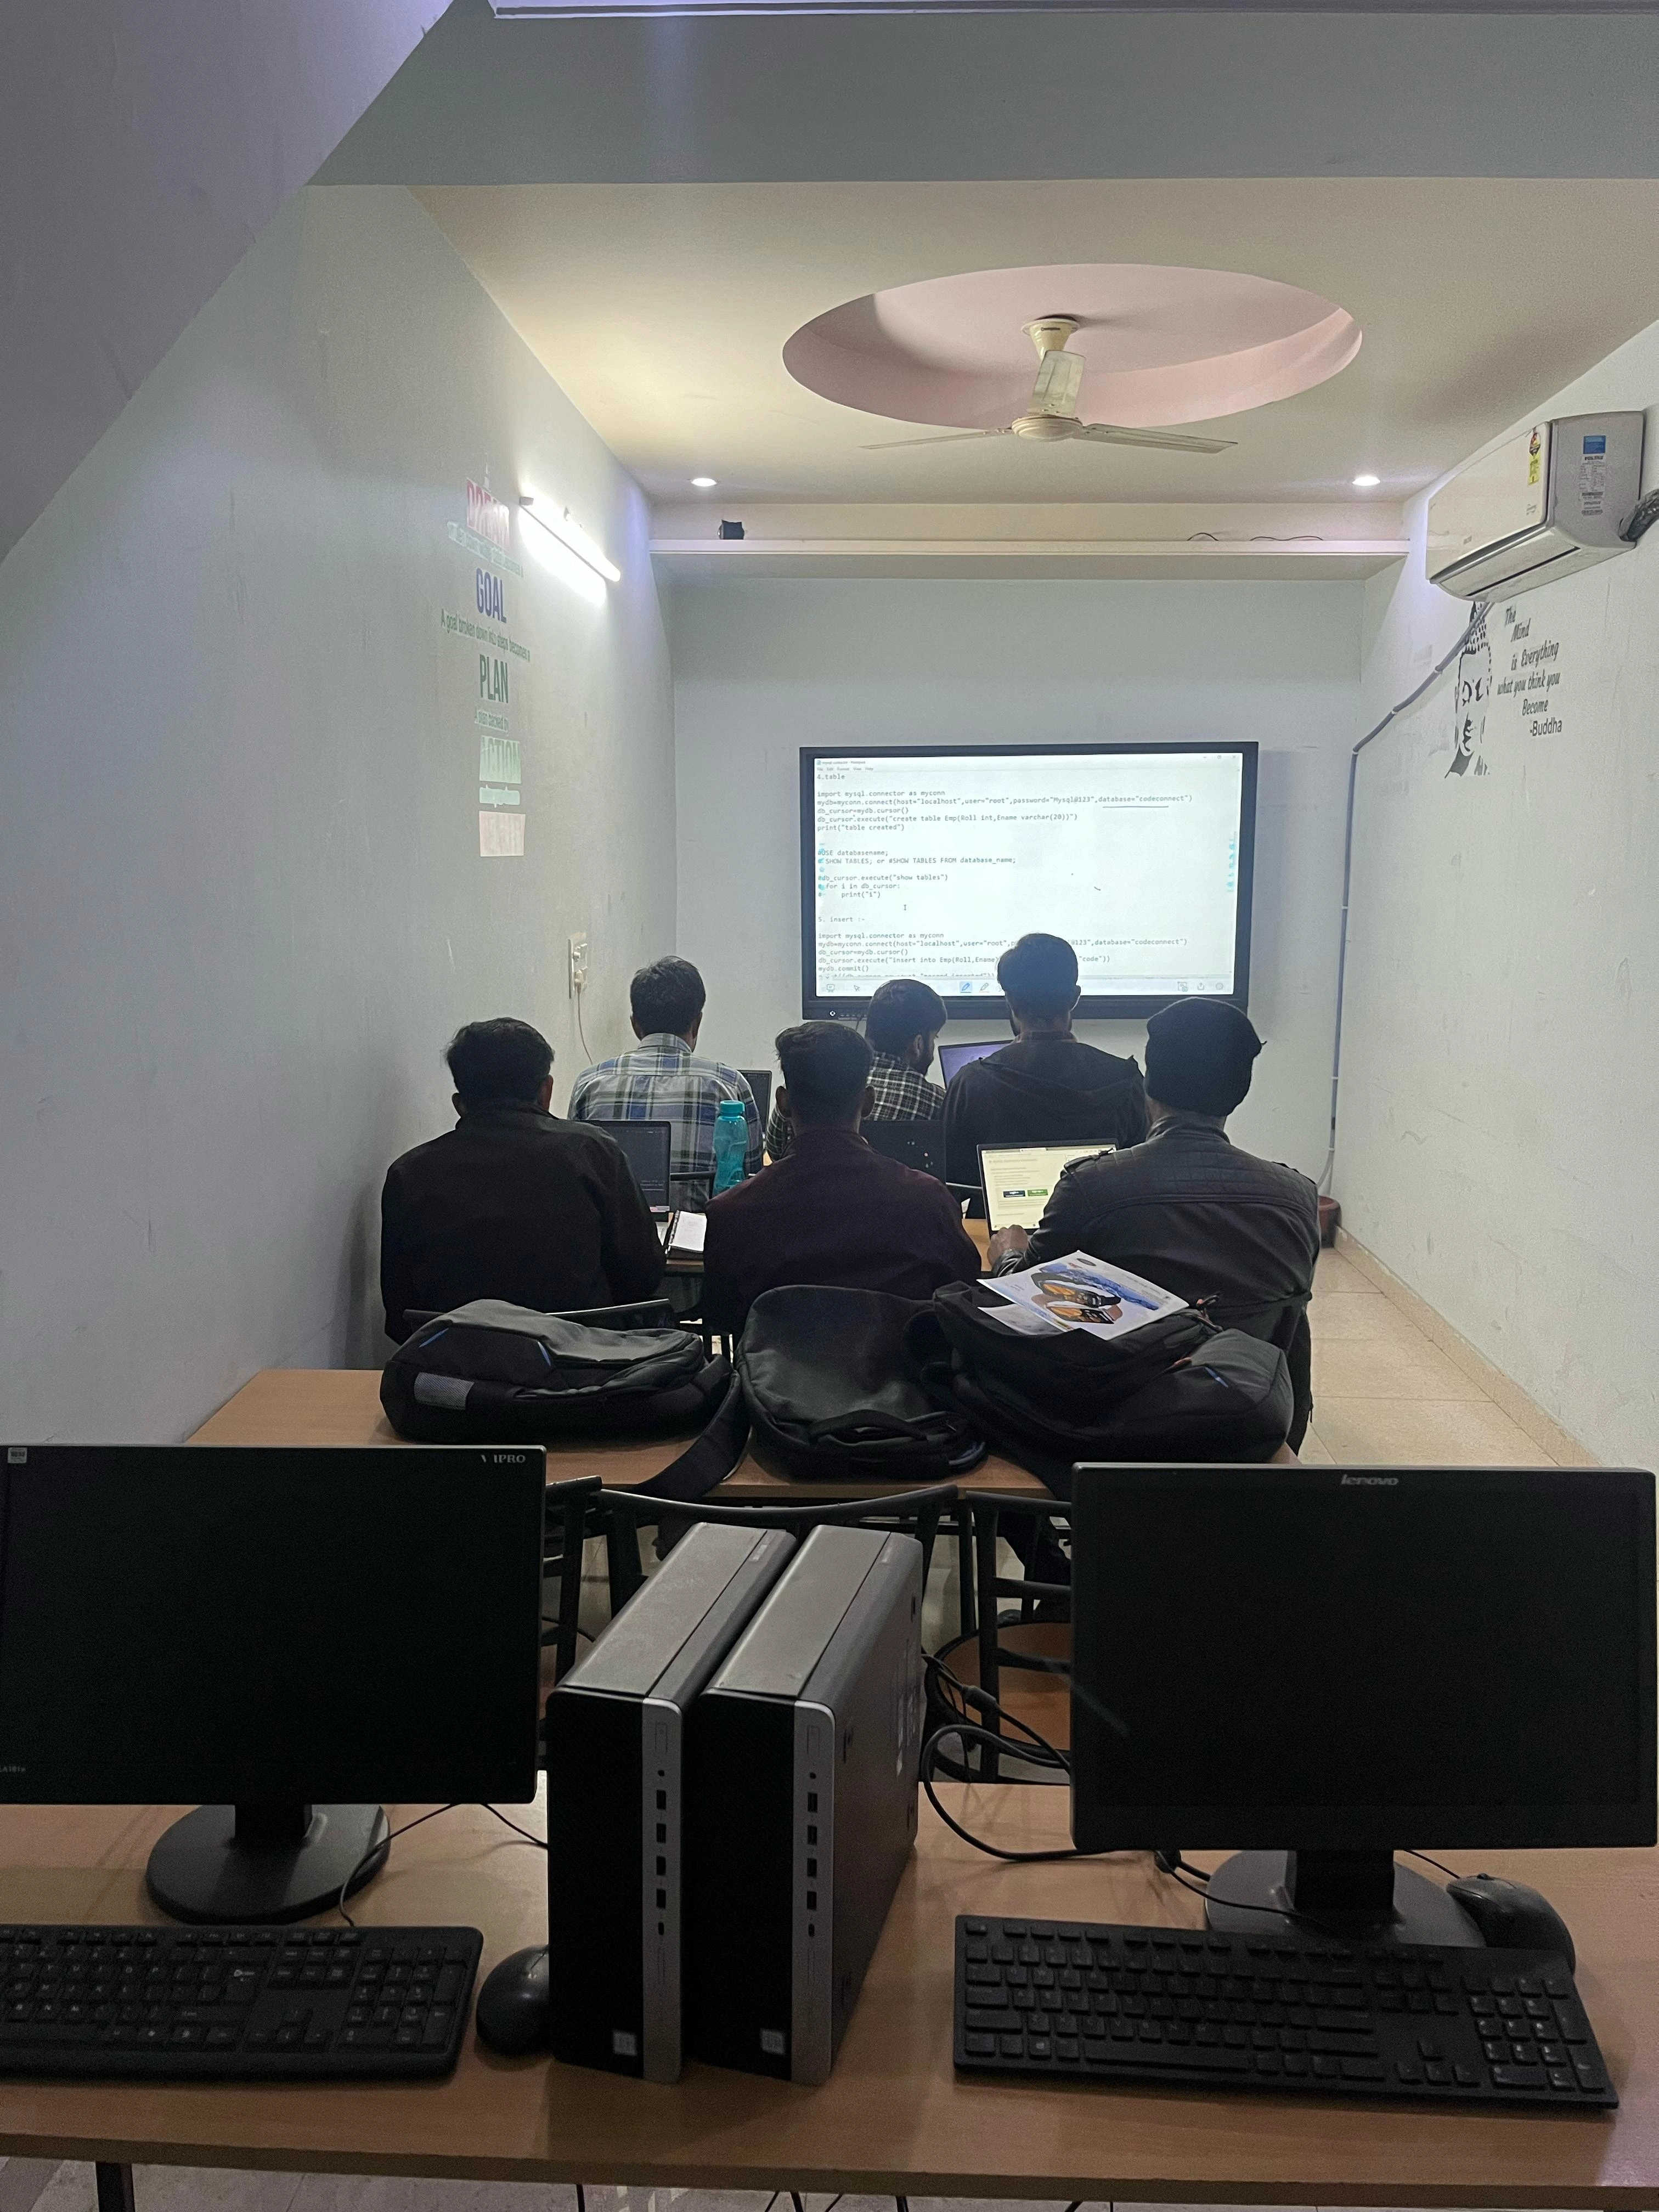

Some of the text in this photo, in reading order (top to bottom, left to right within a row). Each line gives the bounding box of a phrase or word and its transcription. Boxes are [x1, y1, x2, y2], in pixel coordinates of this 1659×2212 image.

[476, 567, 507, 623] GOAL
[441, 608, 445, 627] A
[446, 612, 458, 633] goal
[1505, 605, 1516, 628] The
[1511, 618, 1531, 642] Mind
[1511, 640, 1559, 671] is Everything
[479, 653, 509, 703] PLAN
[1497, 668, 1561, 698] what you think you
[1522, 698, 1548, 716] Become
[817, 807, 909, 815] db_cursor=mydb.cursor()
